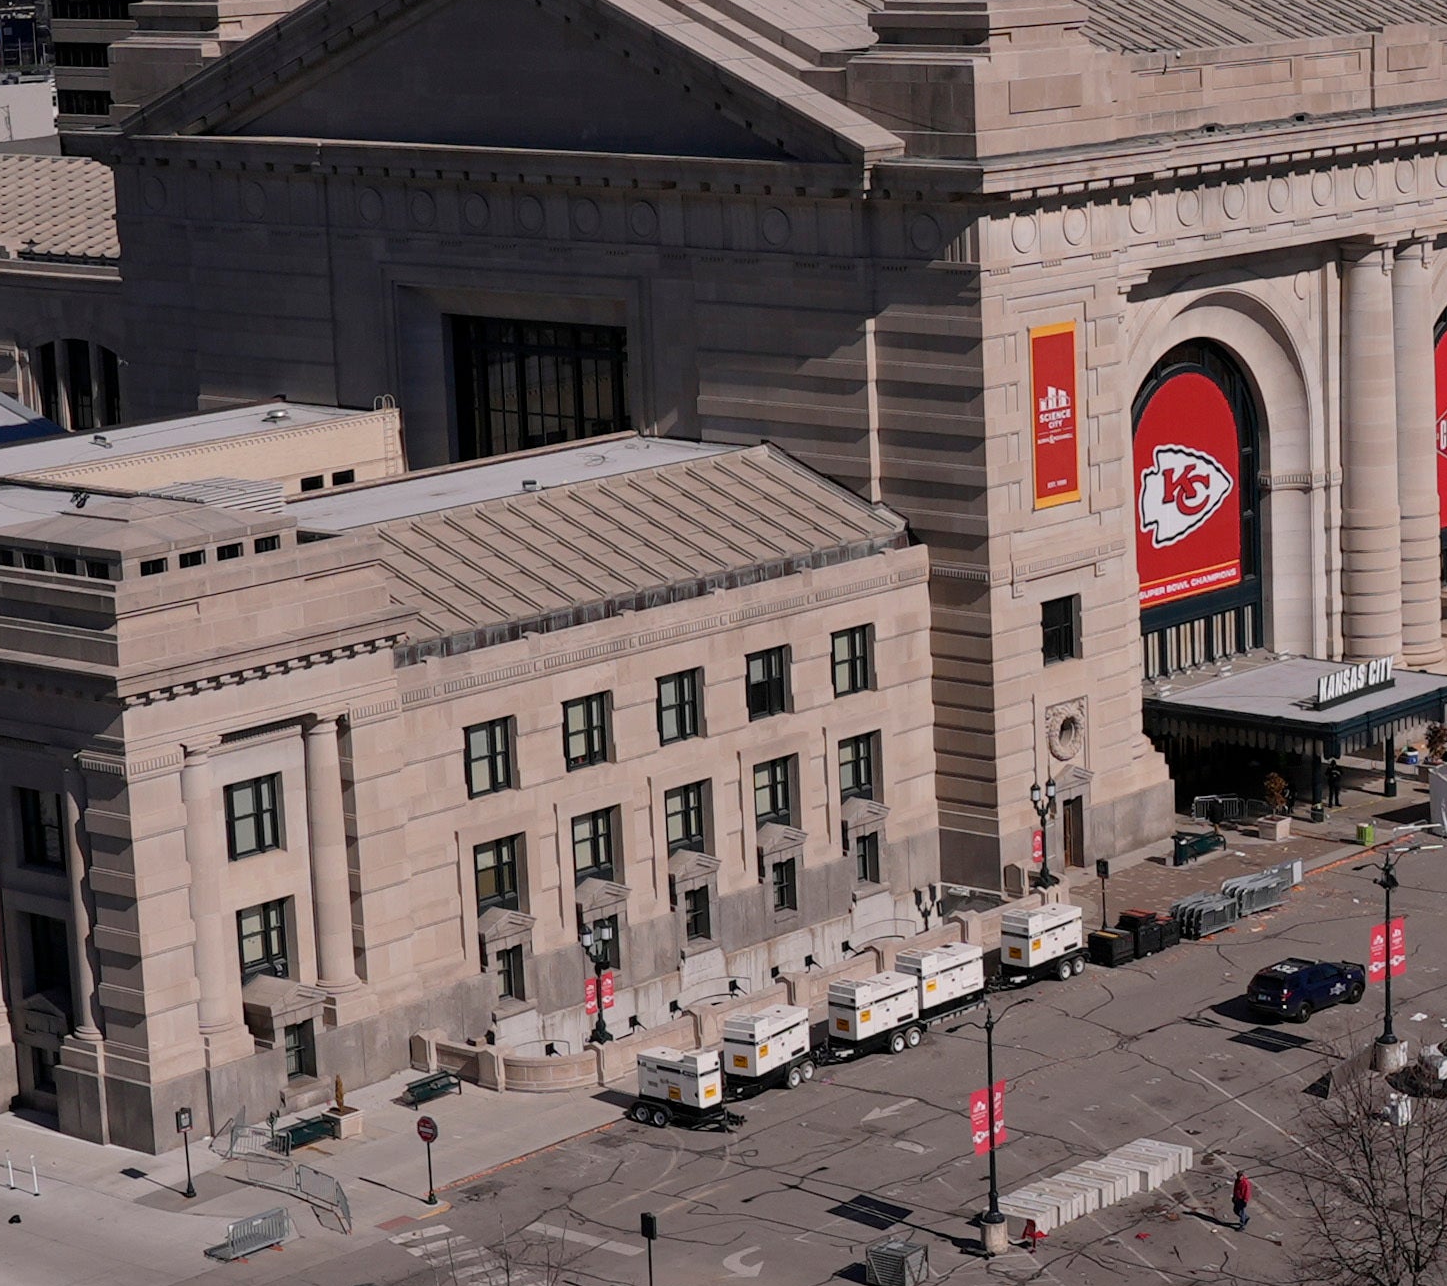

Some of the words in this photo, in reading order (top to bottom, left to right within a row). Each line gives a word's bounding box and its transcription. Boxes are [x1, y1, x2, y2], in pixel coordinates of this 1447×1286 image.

[1039, 409, 1072, 424] SCIENCE
[1048, 420, 1064, 429] CITY
[1162, 464, 1211, 515] KC
[1139, 586, 1166, 601] SUPER
[1166, 579, 1190, 593] BOWL
[1191, 567, 1237, 587] CHAMPIONS
[1319, 663, 1366, 703] KANSAS
[1368, 655, 1394, 686] CITY
